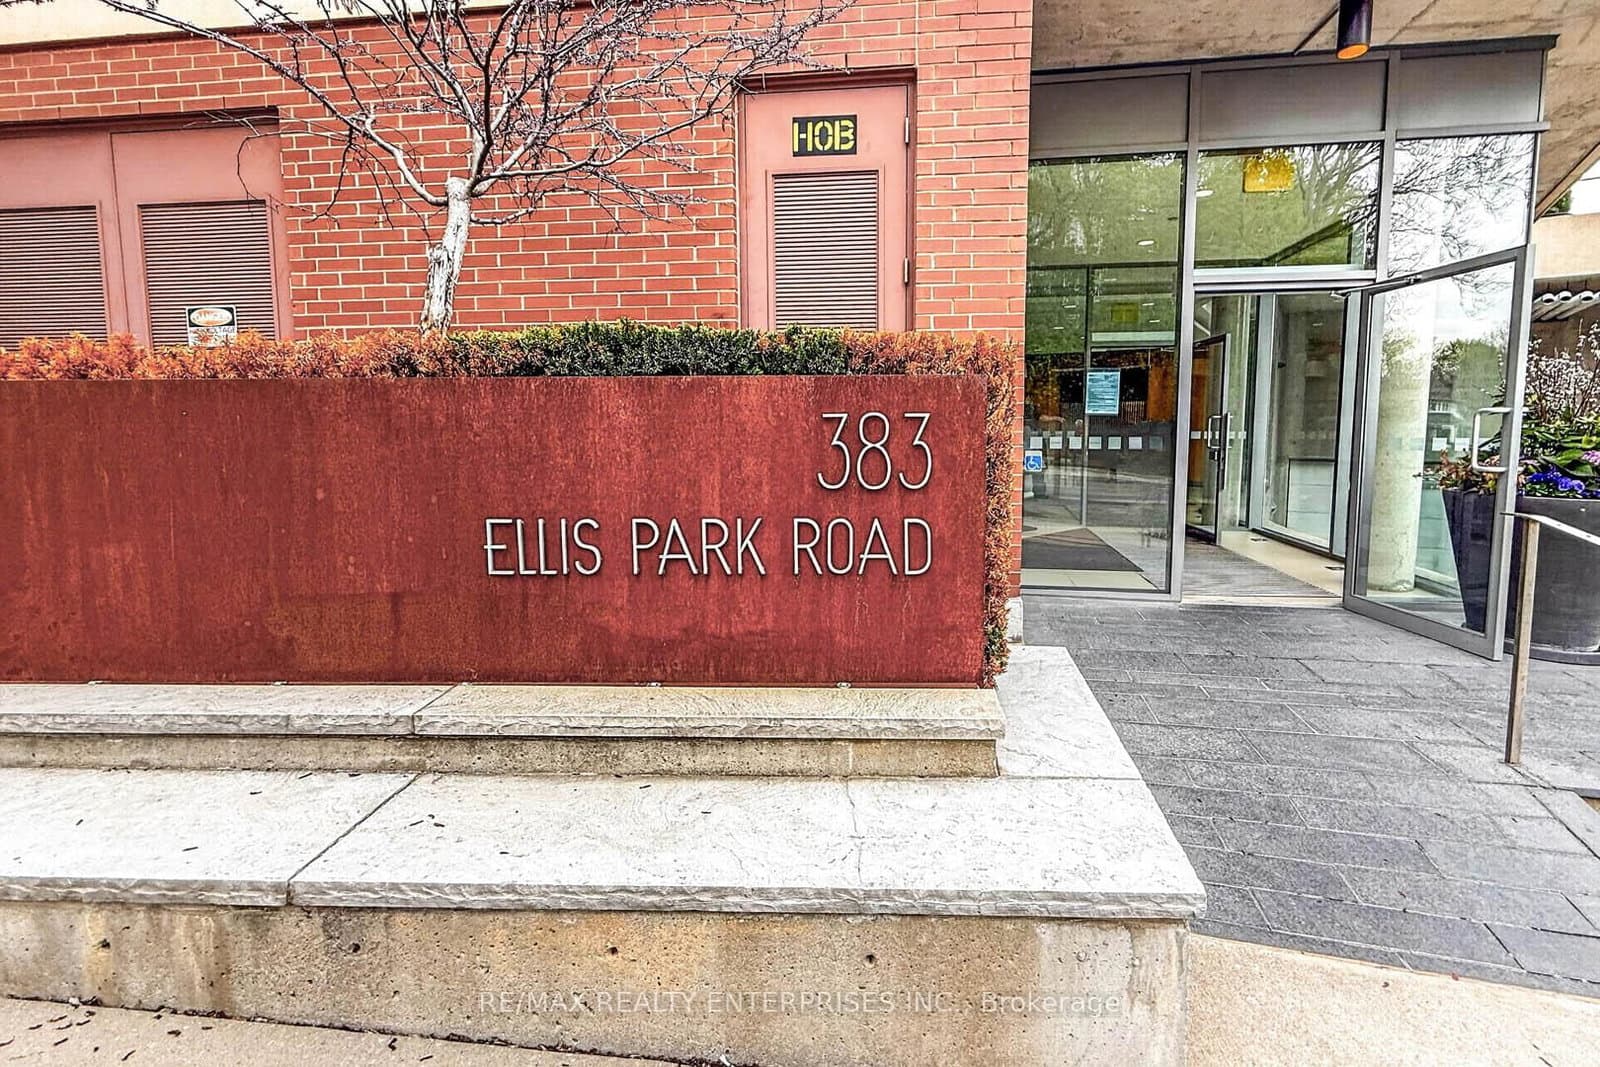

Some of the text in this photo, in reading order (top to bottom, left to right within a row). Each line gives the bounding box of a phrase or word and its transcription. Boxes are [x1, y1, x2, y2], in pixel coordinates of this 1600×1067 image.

[793, 119, 855, 152] HOB
[817, 411, 933, 490] 383
[483, 517, 933, 576] ELLIS PARK ROAD
